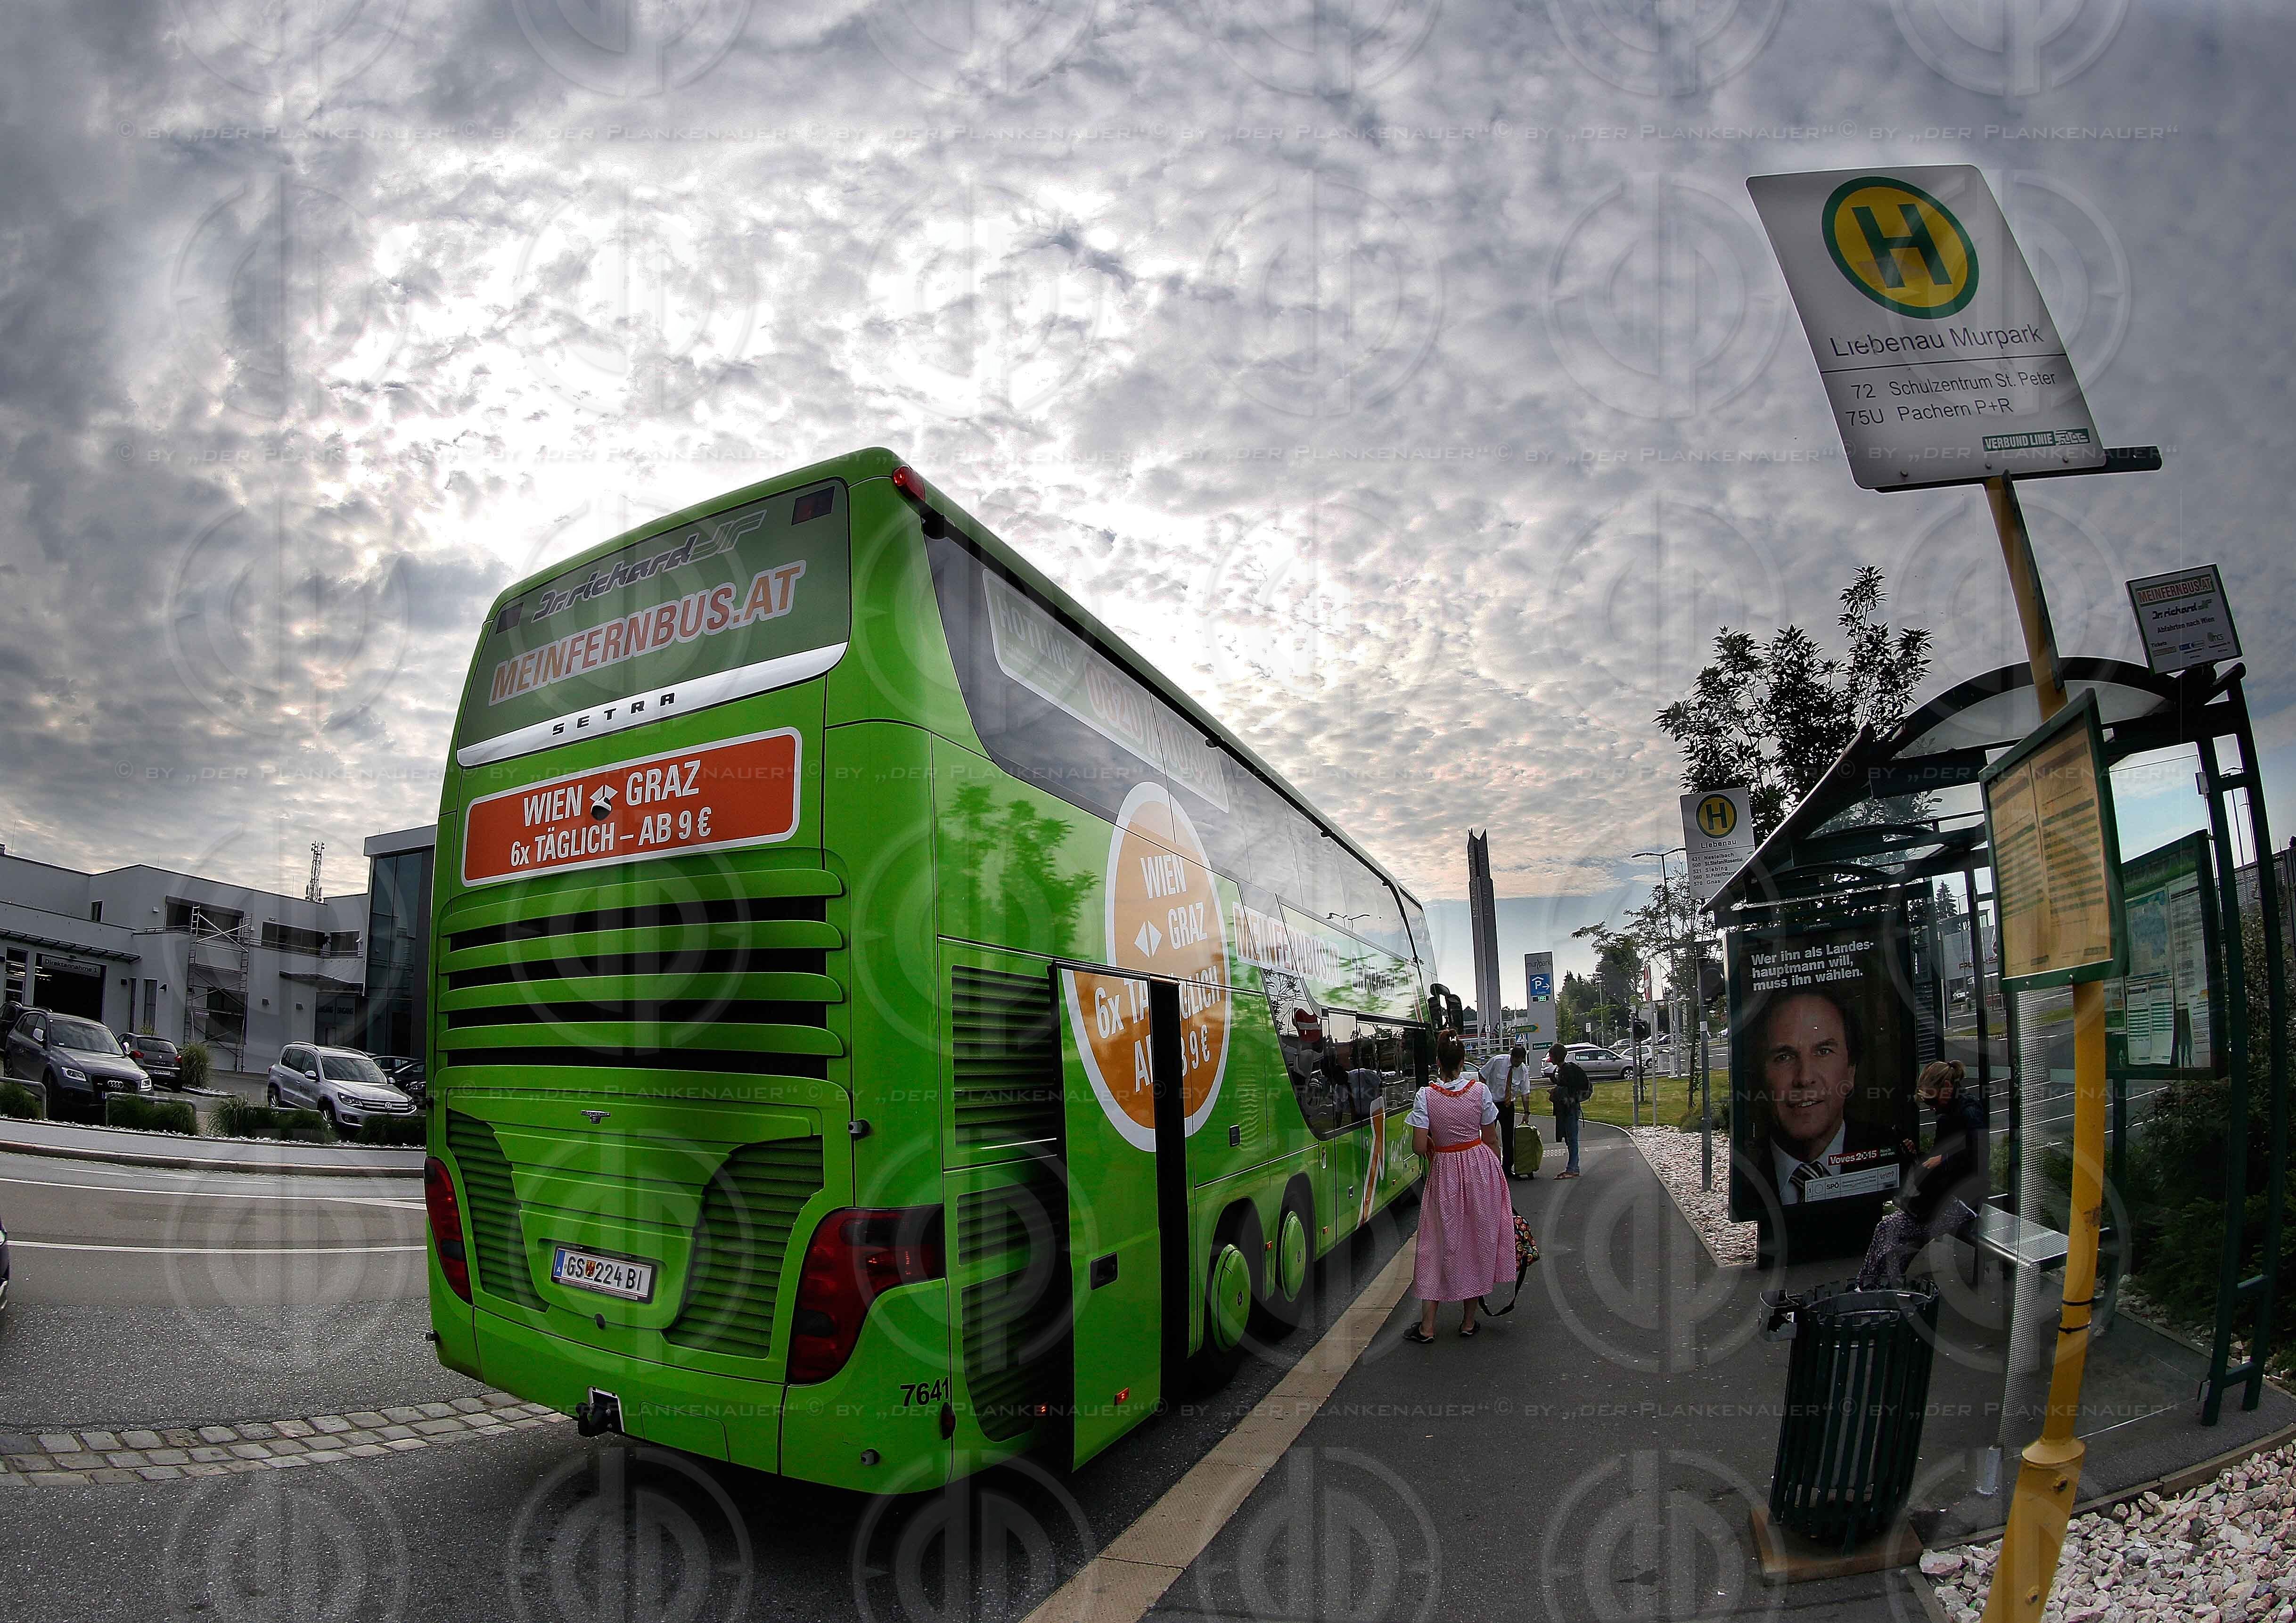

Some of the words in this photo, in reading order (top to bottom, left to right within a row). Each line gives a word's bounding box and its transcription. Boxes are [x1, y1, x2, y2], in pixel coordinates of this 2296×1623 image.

[1851, 204, 1953, 288] H
[1829, 333, 1945, 357] Liebenau
[1949, 324, 2044, 349] Murpark
[1851, 384, 1876, 400] 72
[1889, 376, 1993, 396] Schulzentrum
[1995, 373, 2016, 387] St.
[2018, 371, 2056, 386] Peter
[1845, 409, 1884, 426] 75U
[1896, 403, 1971, 421] Pachern
[1975, 398, 2014, 414] P+R
[1984, 435, 2028, 449] VERBUND
[2030, 433, 2053, 445] LINIE
[2137, 577, 2212, 604] MEINFERNBUS.AT
[489, 564, 802, 702] MEINFERNBUS.AT
[997, 595, 1075, 676] HOTLINE
[2157, 623, 2186, 634] Abfahrten
[552, 692, 677, 736] SETRA
[523, 785, 583, 827] WIEN
[626, 759, 701, 806] GRAZ
[1706, 803, 1728, 830] H
[510, 841, 530, 867] 6x
[534, 821, 615, 862] TÄGLICH
[638, 812, 672, 846] AB
[1701, 840, 1737, 849] Liebenau
[1140, 854, 1187, 899] WIEN
[1167, 902, 1208, 950] GRAZ
[45, 959, 92, 972] Direktannahme
[1751, 954, 1777, 965] Wer
[1780, 951, 1800, 961] ihn
[1804, 946, 1823, 959] als
[1826, 941, 1874, 955] Landes-
[1752, 960, 1825, 978] hauptmann
[1829, 954, 1853, 968] will,
[1753, 979, 1788, 991] muss
[1791, 975, 1812, 986] ihn
[1815, 967, 1863, 983] wählen.
[1095, 987, 1124, 1039] 6x
[566, 1256, 585, 1278] GS
[594, 1262, 622, 1287] 224
[900, 1377, 949, 1408] 7641
